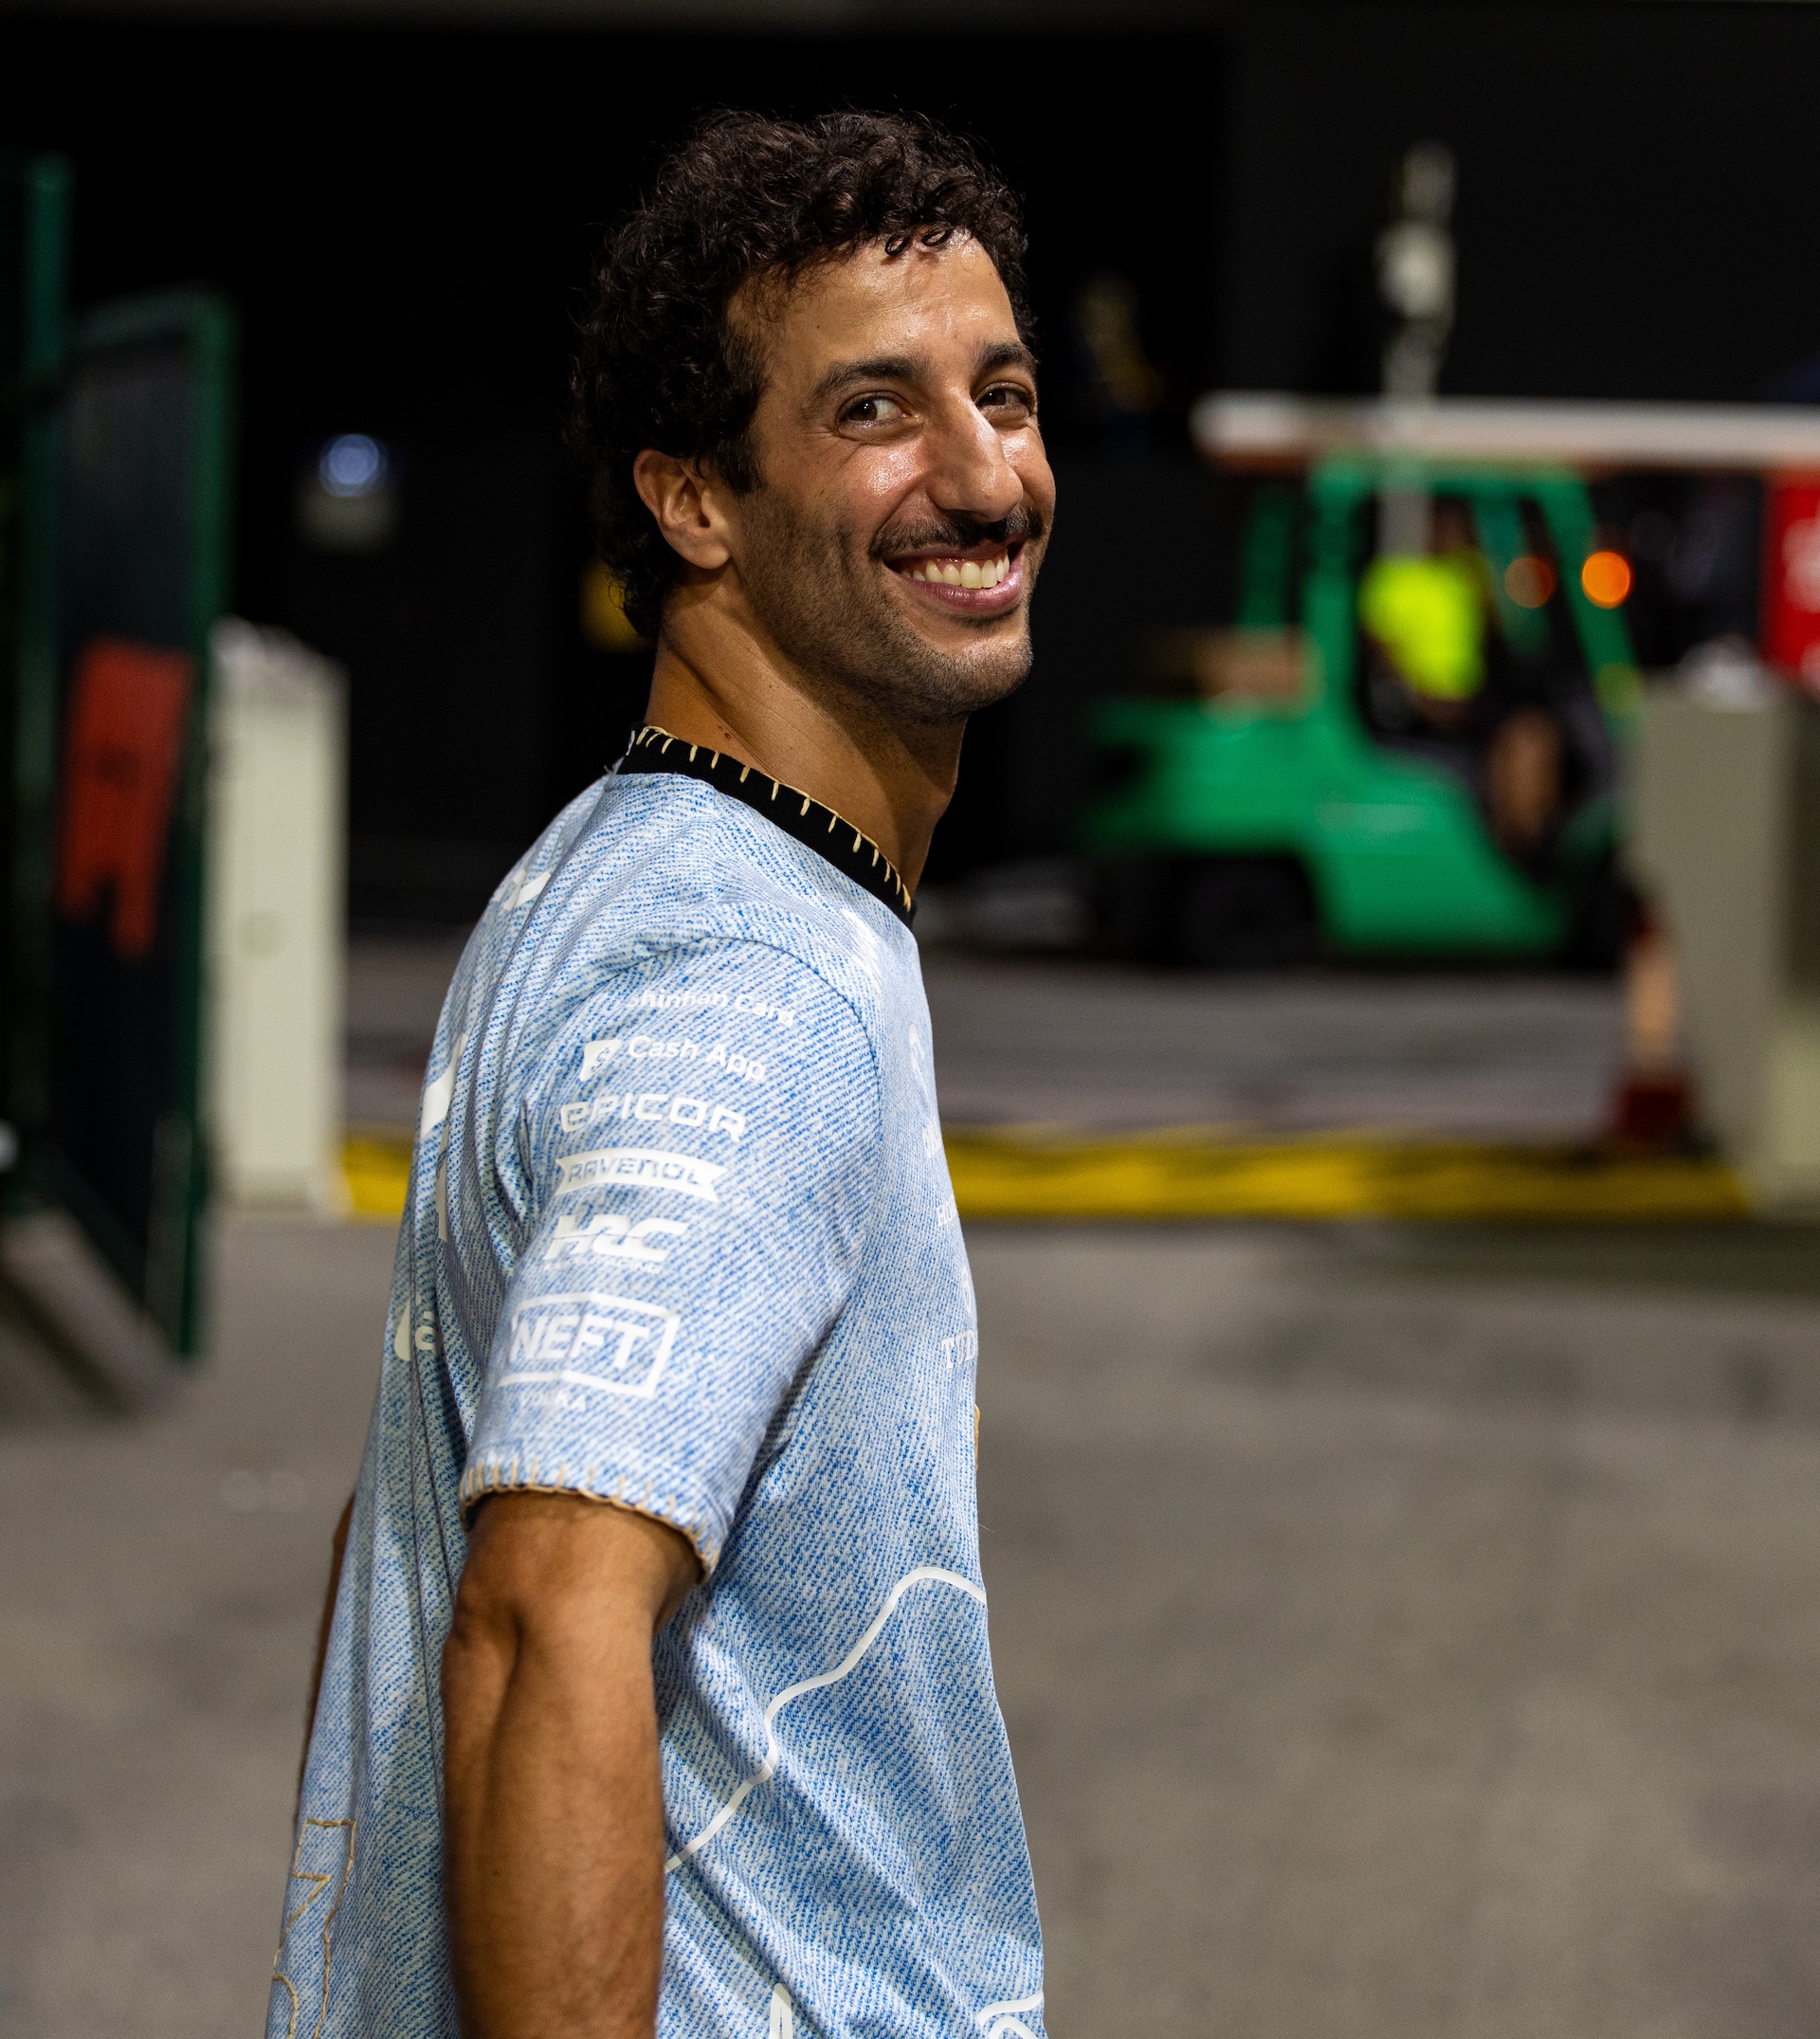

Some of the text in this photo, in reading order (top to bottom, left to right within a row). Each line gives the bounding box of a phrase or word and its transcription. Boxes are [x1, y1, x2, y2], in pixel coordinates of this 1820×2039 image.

[735, 993, 796, 1027] Card
[628, 1035, 766, 1081] Cash App
[568, 1156, 704, 1186] RAVENOL
[508, 1313, 651, 1371] NEFT
